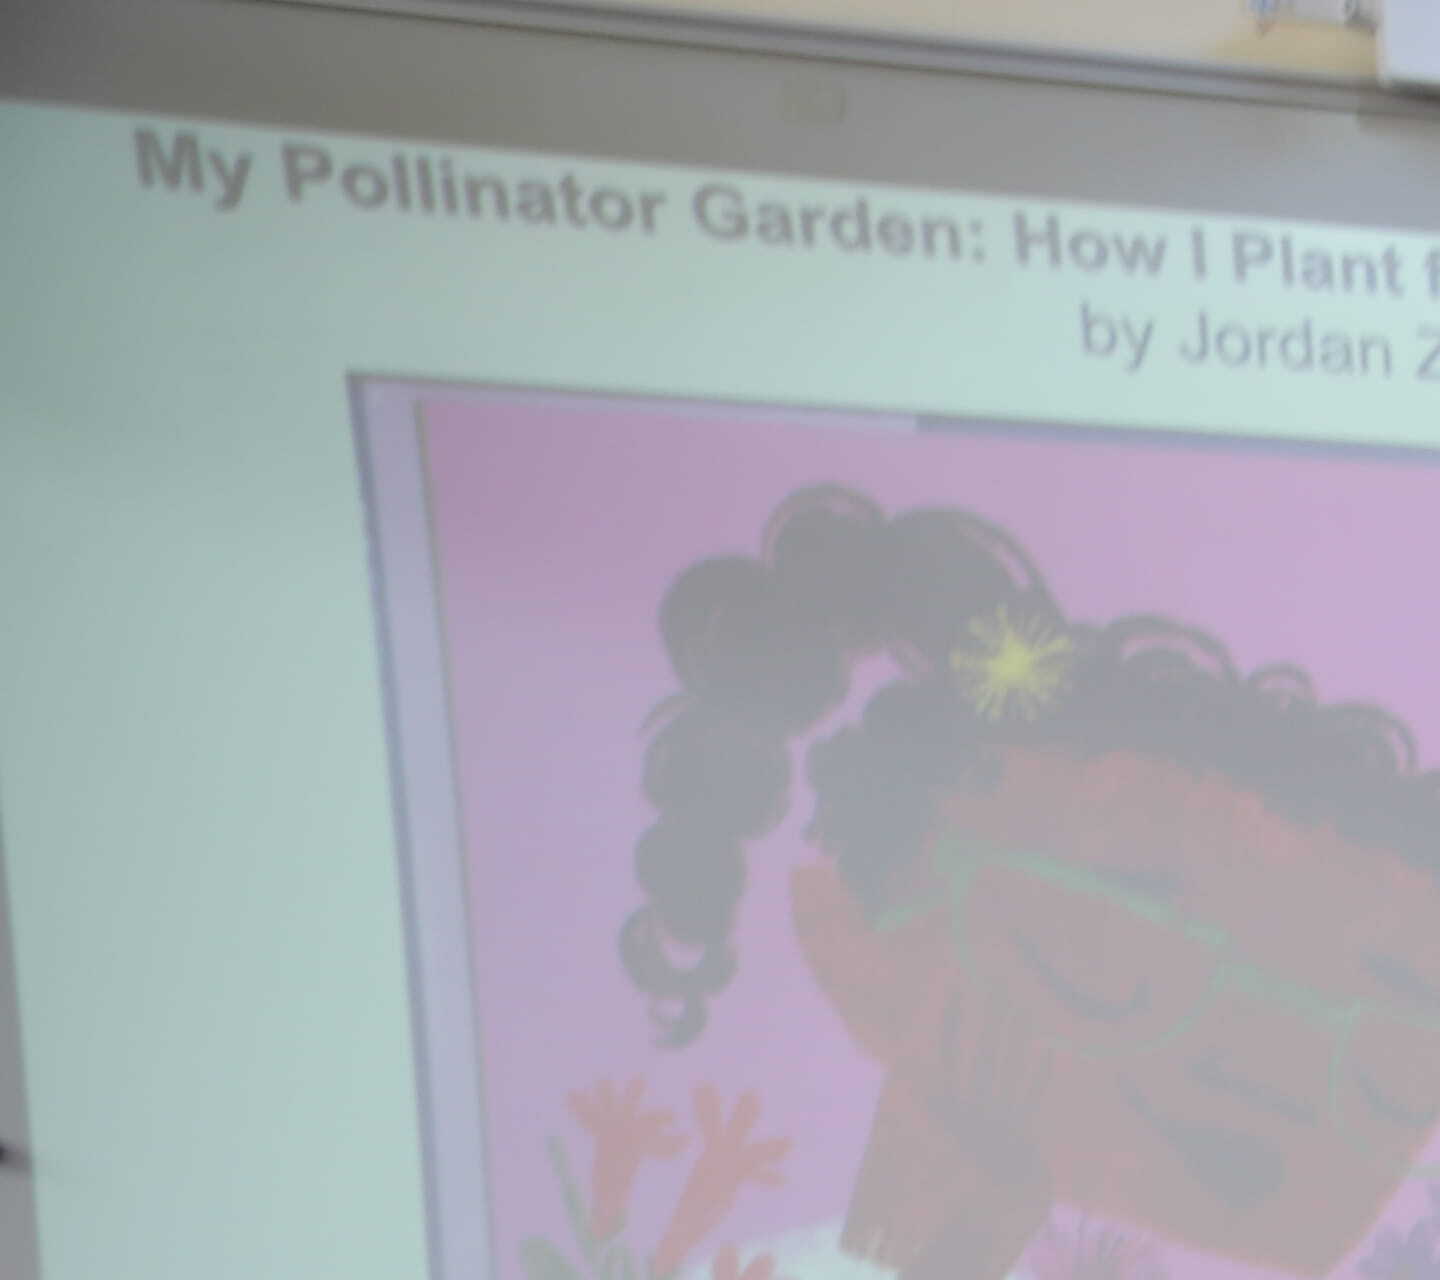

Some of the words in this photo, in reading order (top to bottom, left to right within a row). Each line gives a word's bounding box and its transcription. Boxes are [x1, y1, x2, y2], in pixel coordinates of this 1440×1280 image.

[132, 126, 253, 210] My
[281, 139, 666, 230] Pollinator
[690, 182, 988, 258] Garden:
[1013, 212, 1170, 275] How
[1190, 228, 1207, 280] I
[1233, 232, 1407, 296] Plant
[1080, 300, 1154, 372] by
[1181, 310, 1392, 378] Jordan
